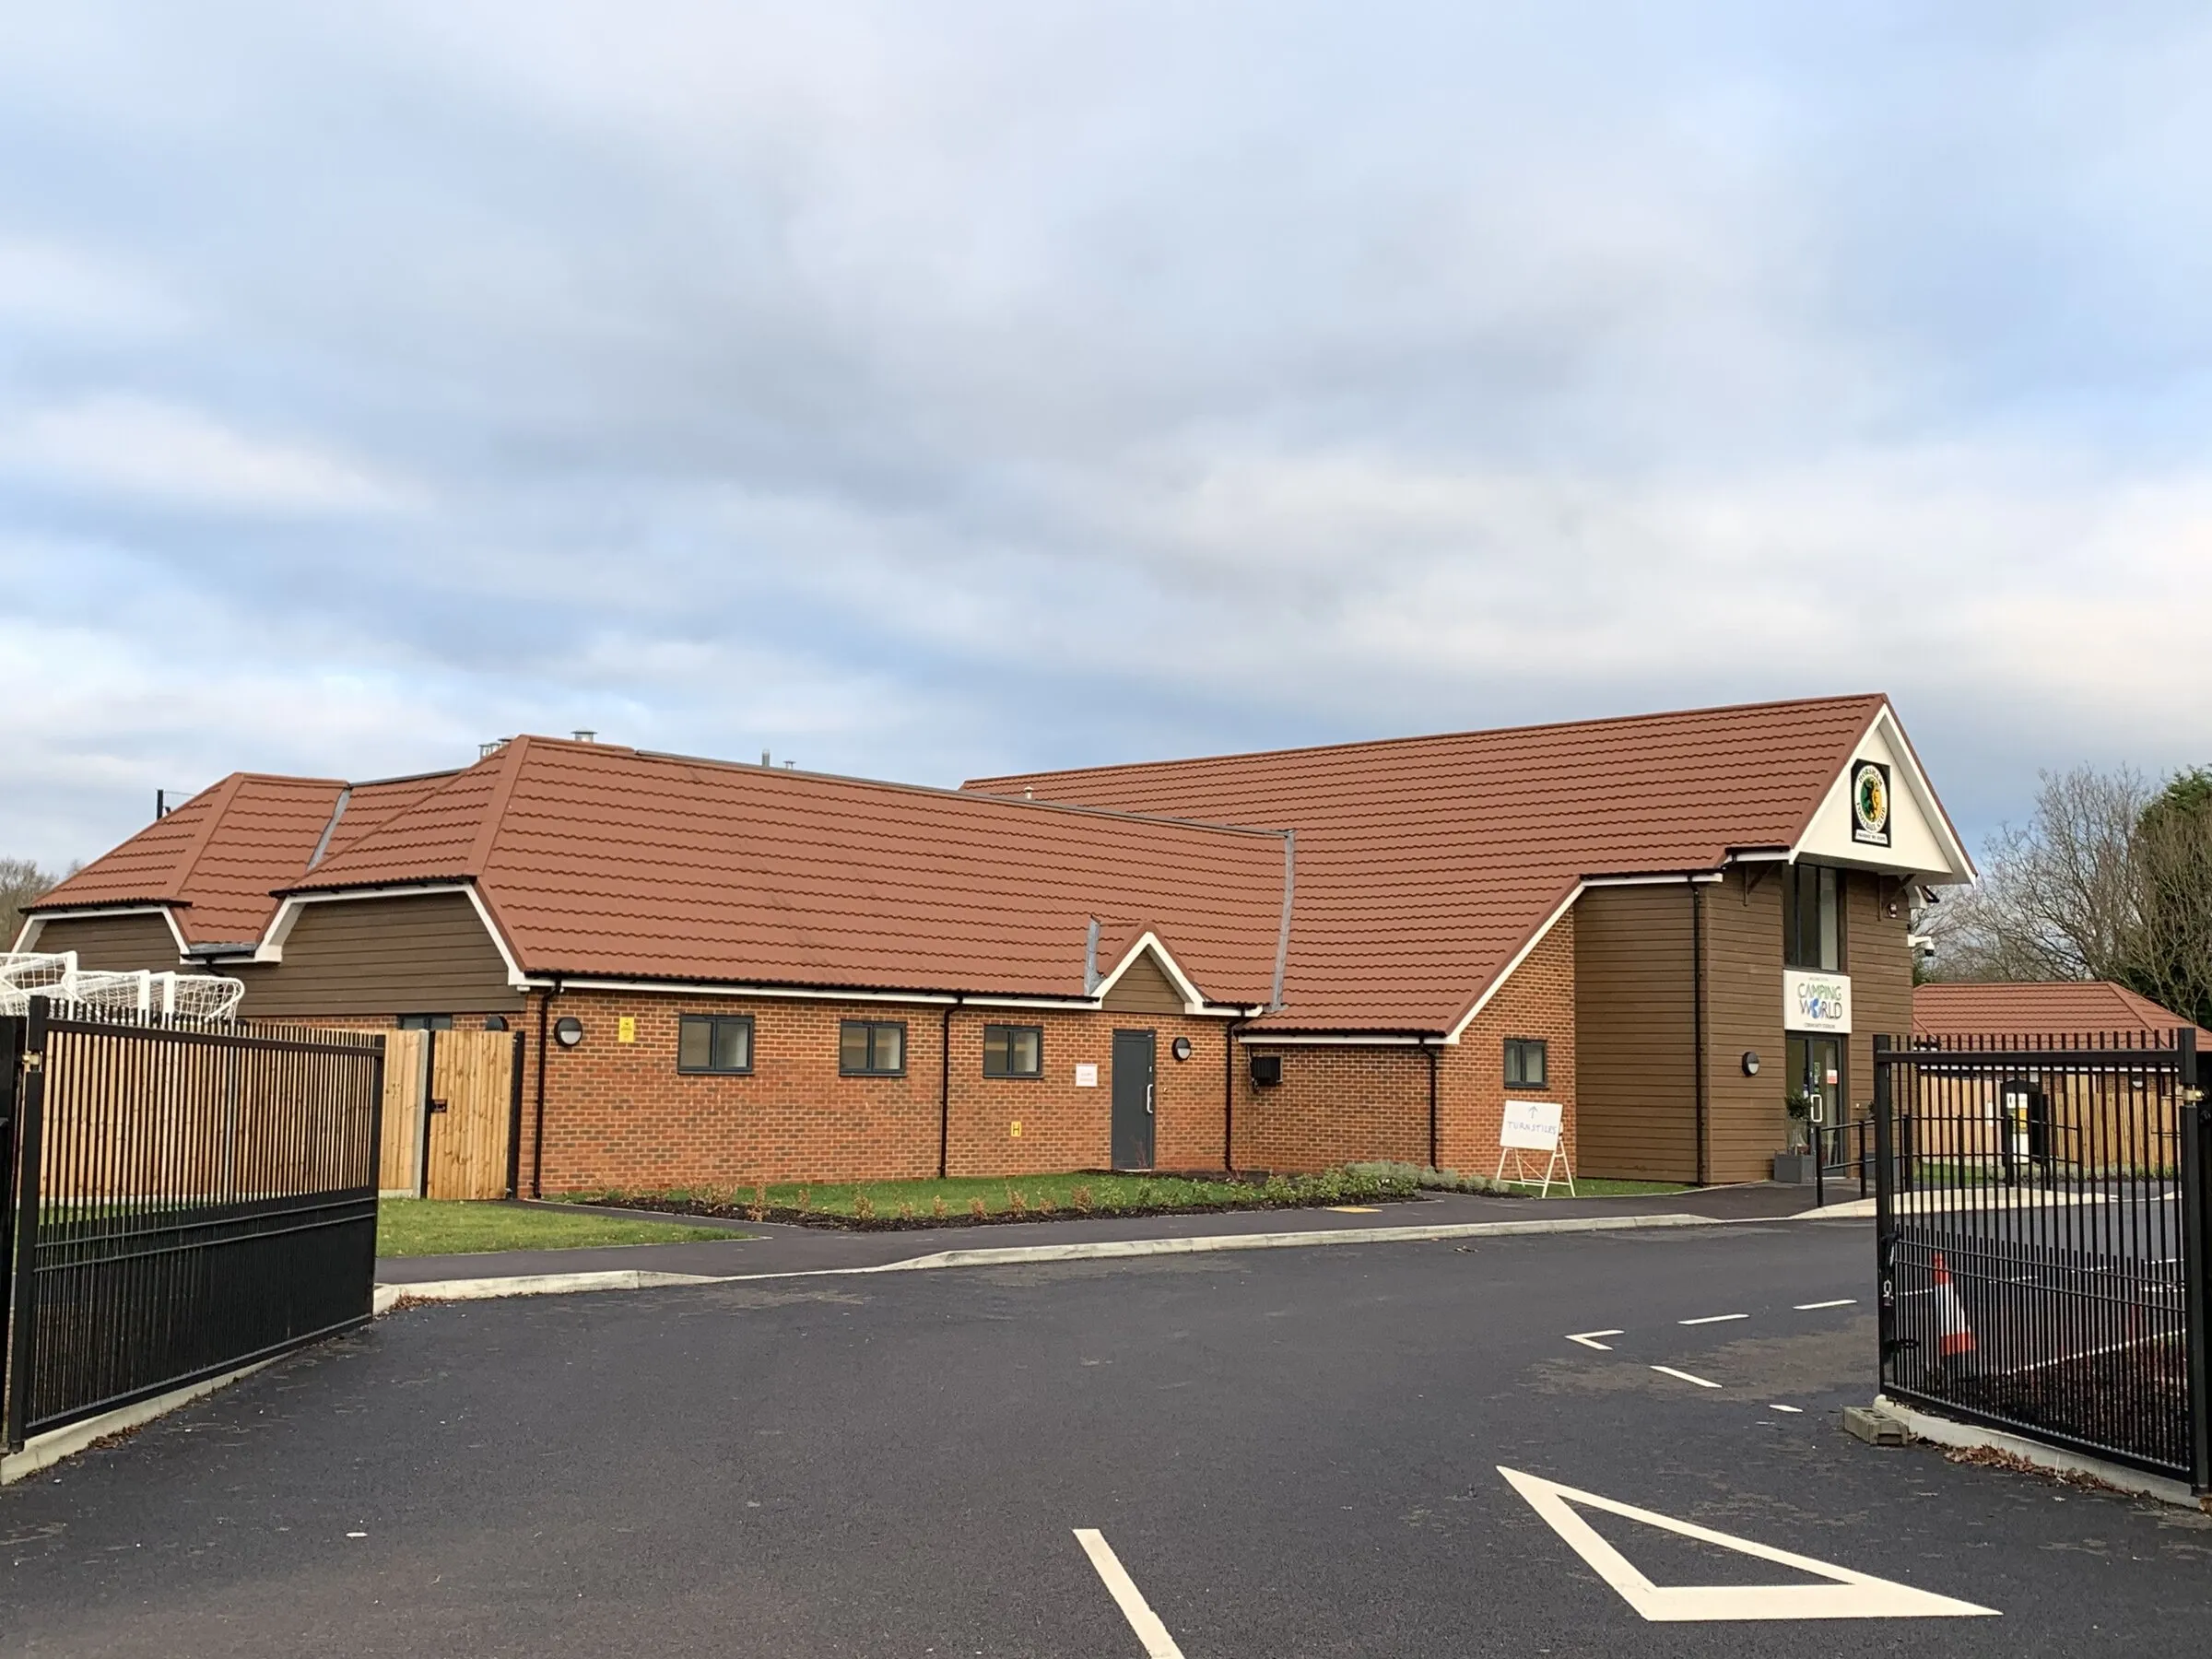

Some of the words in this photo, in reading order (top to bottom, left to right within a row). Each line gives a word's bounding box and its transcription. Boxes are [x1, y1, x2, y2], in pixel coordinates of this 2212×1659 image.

[1797, 982, 1842, 1001] CAMPING
[1799, 998, 1843, 1019] WORLD
[1013, 1124, 1019, 1135] H
[1508, 1121, 1558, 1135] TURNSTILES
